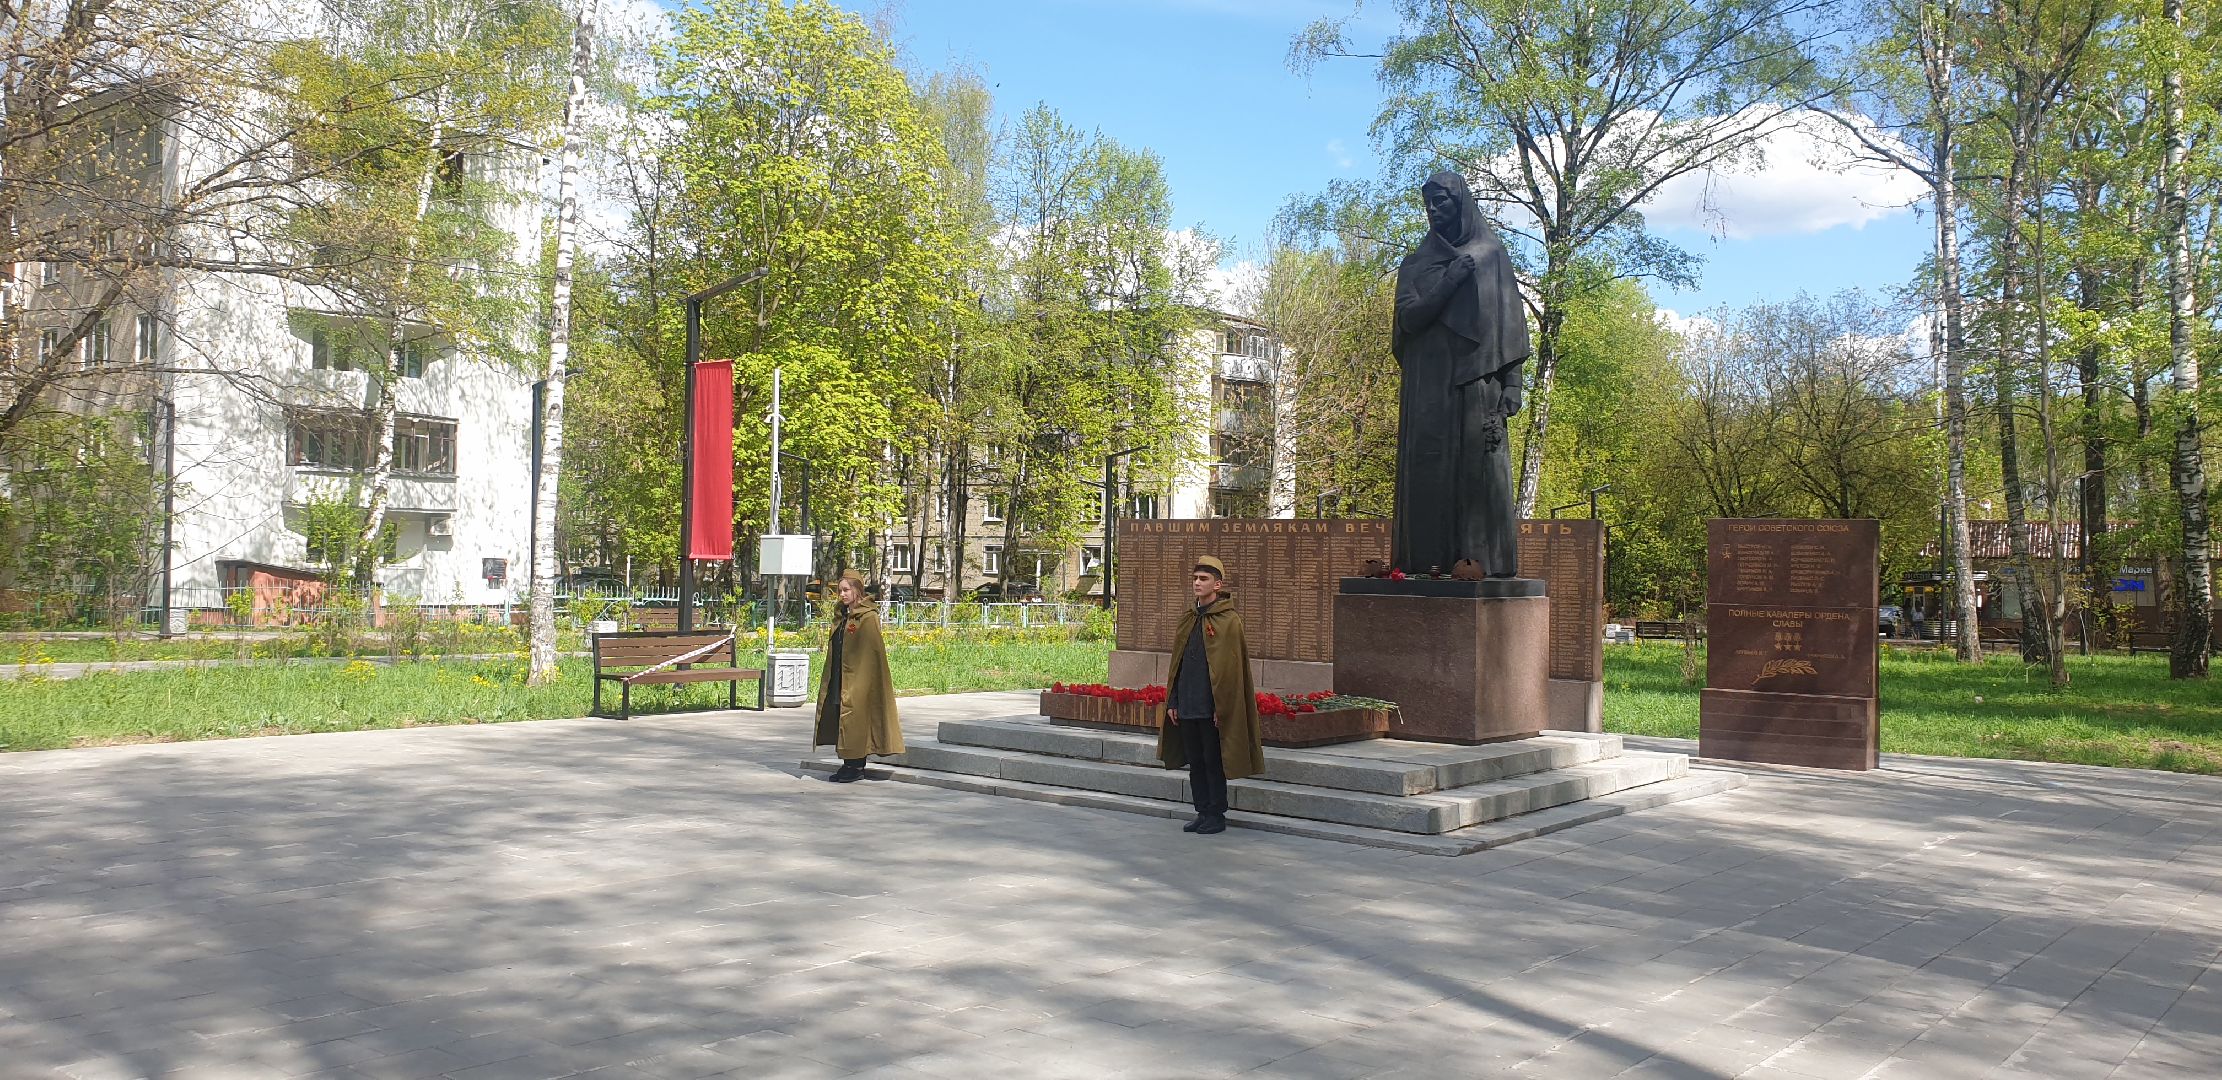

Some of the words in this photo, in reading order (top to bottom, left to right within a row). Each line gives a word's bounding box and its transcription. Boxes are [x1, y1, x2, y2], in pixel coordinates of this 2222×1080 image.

[1130, 522, 1210, 533] ПАВШИМ
[1221, 522, 1328, 533] ЗЕМЛЯКАМ
[1345, 523, 1386, 533] ВЕЧ
[1520, 523, 1573, 534] ЯТЬ
[1728, 524, 1756, 532] ГЕРОИ
[1758, 524, 1815, 532] СОВЕТСКОГО
[1817, 524, 1849, 532] СОЮЗА
[2119, 565, 2153, 575] Марке
[1728, 609, 1765, 618] ПОЛНЫЕ
[1766, 610, 1811, 619] КАВАЛЕРЫ
[1814, 611, 1850, 620] ОРДЕНА
[1772, 620, 1803, 628] СЛАВЫ
